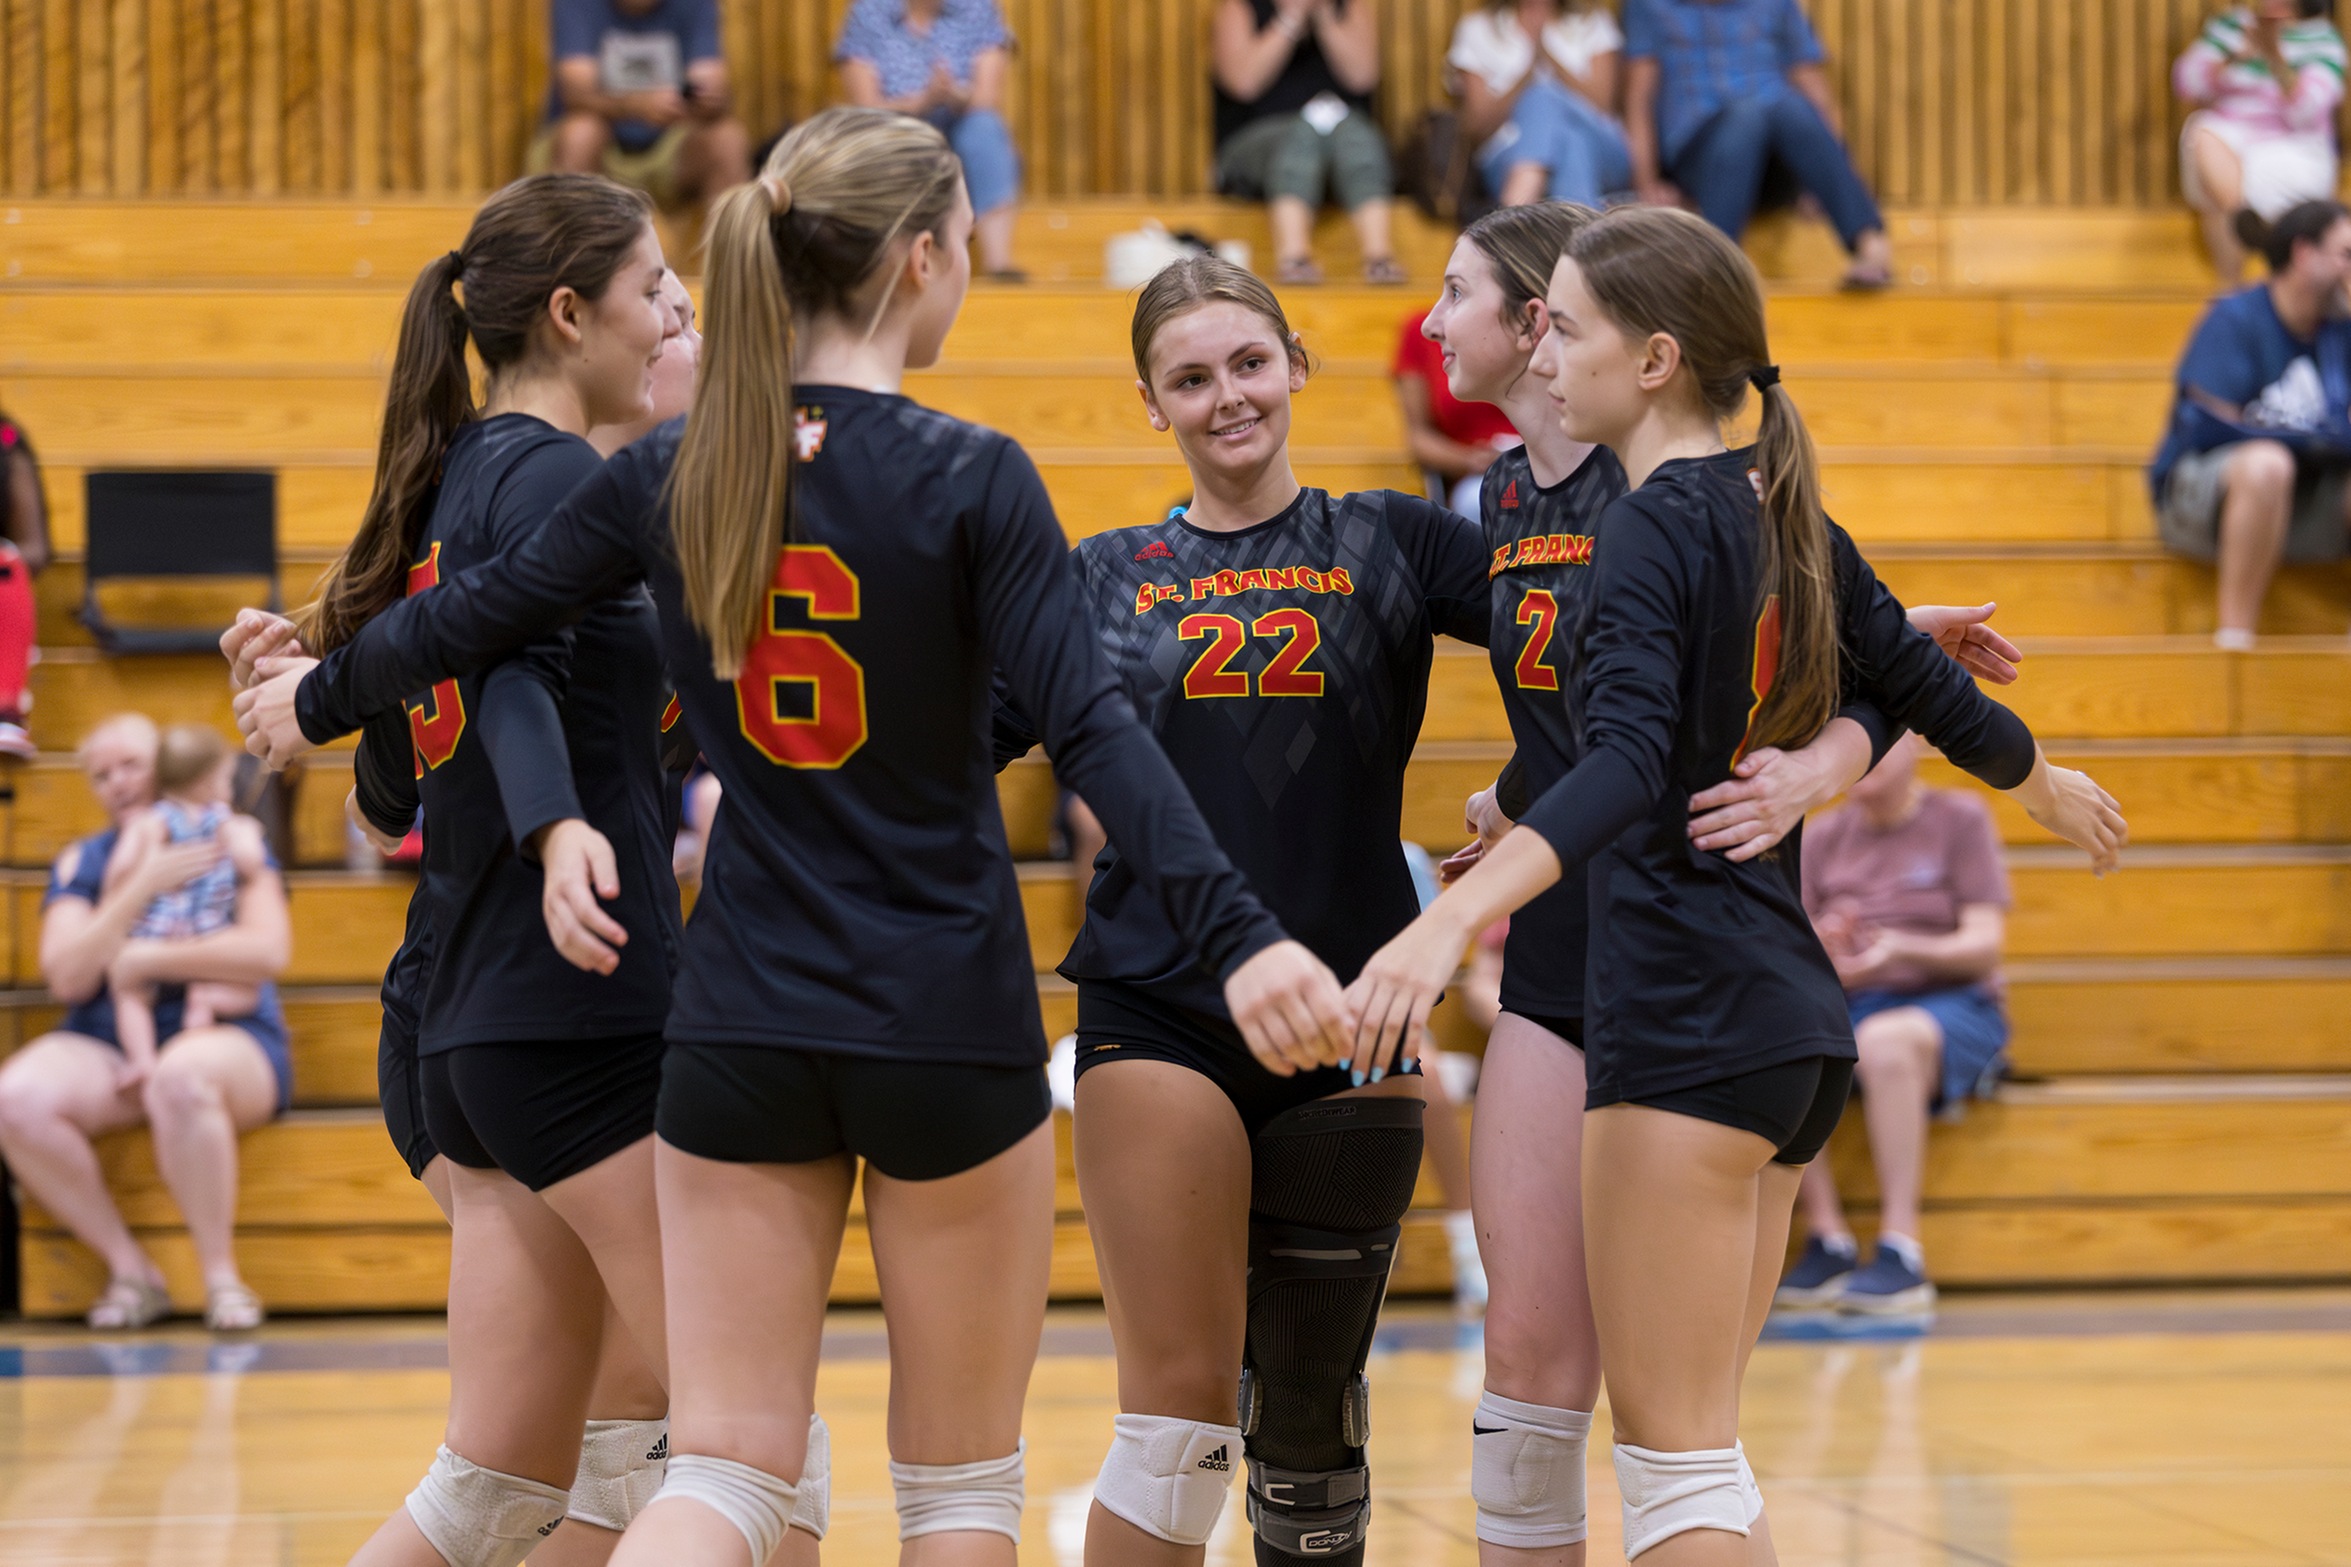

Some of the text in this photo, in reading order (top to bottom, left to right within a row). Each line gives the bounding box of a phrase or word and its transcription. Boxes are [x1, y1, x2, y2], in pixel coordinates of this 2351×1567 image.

[1508, 534, 1595, 568] FRANC
[1189, 566, 1355, 600] FRANCIS
[733, 544, 869, 770] 6
[1178, 607, 1325, 699] 22
[1514, 588, 1560, 691] 2
[1198, 1457, 1230, 1472] adidas
